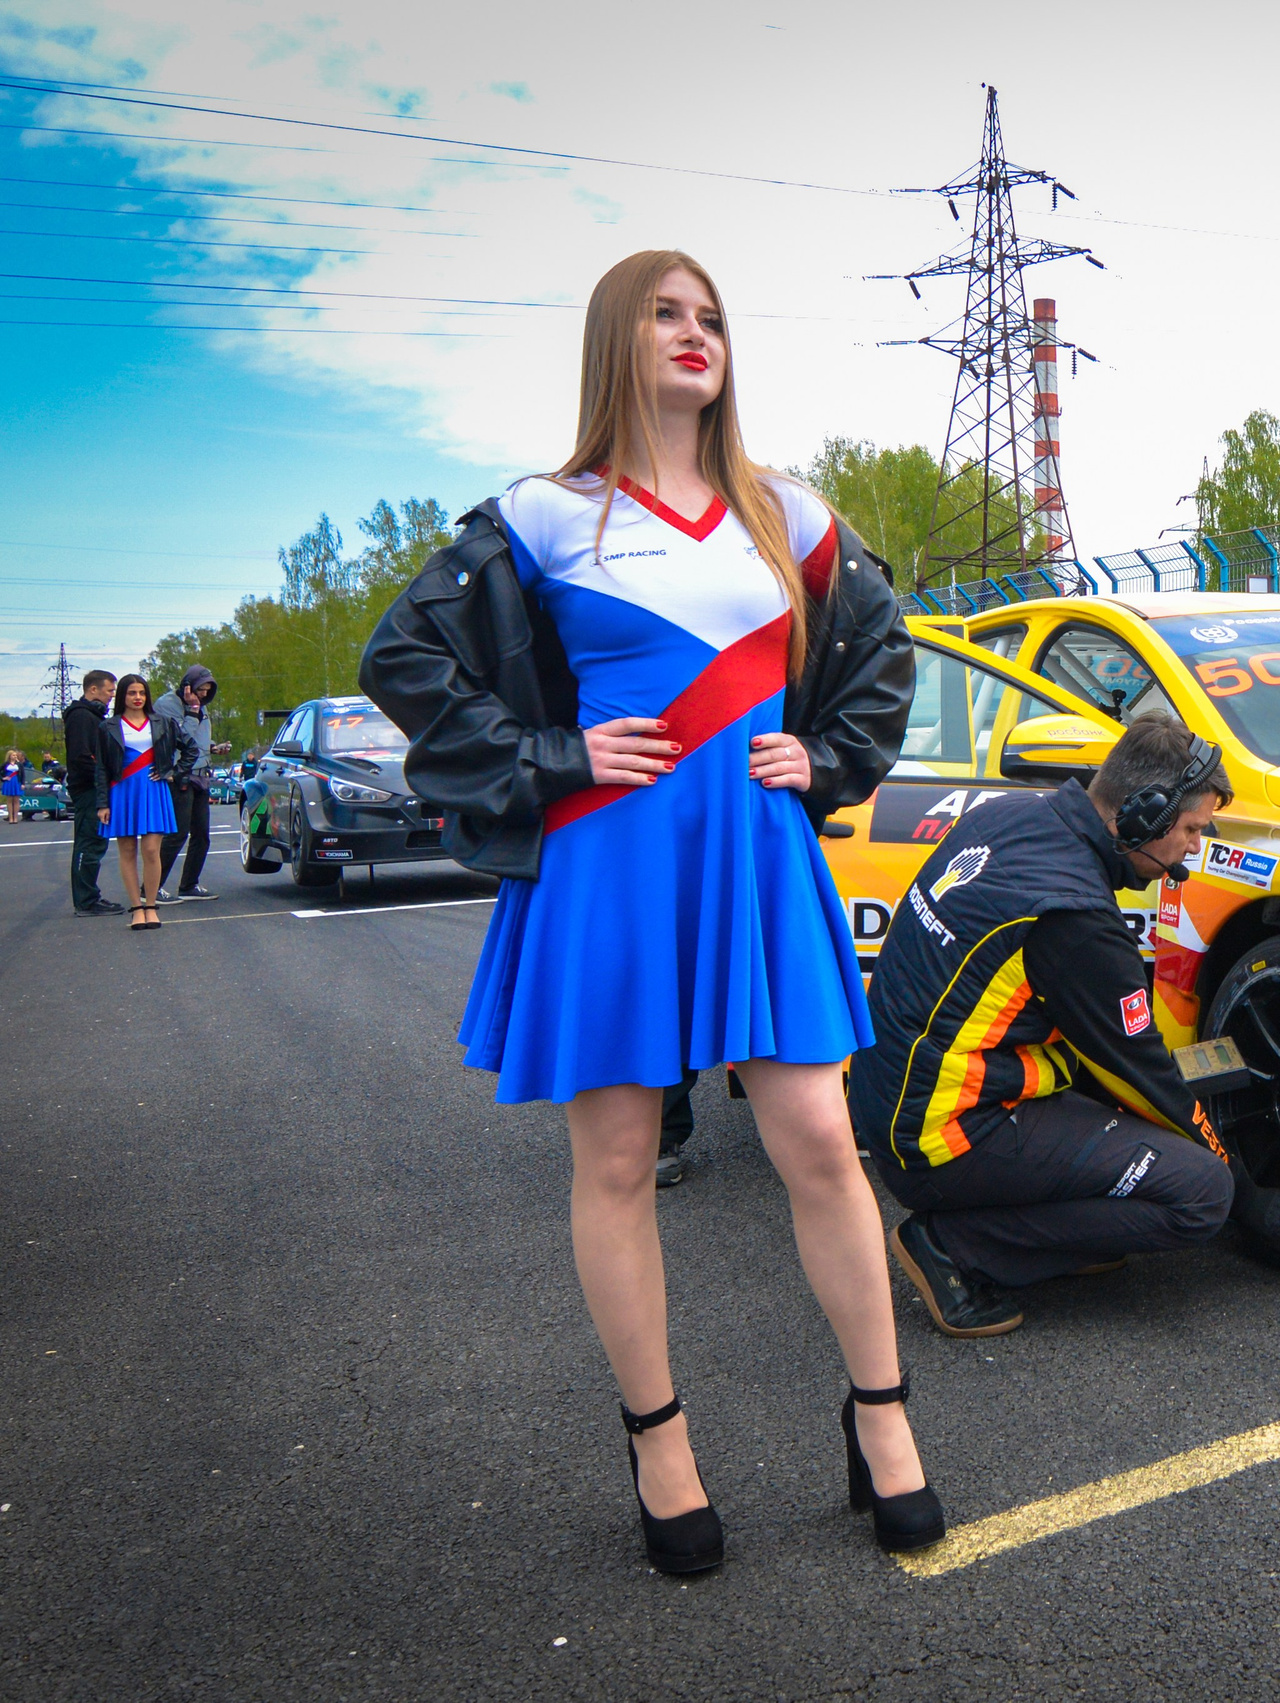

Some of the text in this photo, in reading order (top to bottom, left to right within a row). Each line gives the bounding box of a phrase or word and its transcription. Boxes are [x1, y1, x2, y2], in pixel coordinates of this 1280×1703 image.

[603, 549, 667, 562] SMP RACING
[327, 715, 364, 731] 17
[1209, 842, 1268, 871] TCR Russia
[908, 882, 957, 947] ROSNEFT
[1161, 901, 1178, 916] LADA
[1160, 913, 1178, 922] SPORT
[1128, 1013, 1148, 1028] LADA
[1116, 1150, 1156, 1197] OSNEFT
[1116, 1161, 1137, 1188] SPORT
